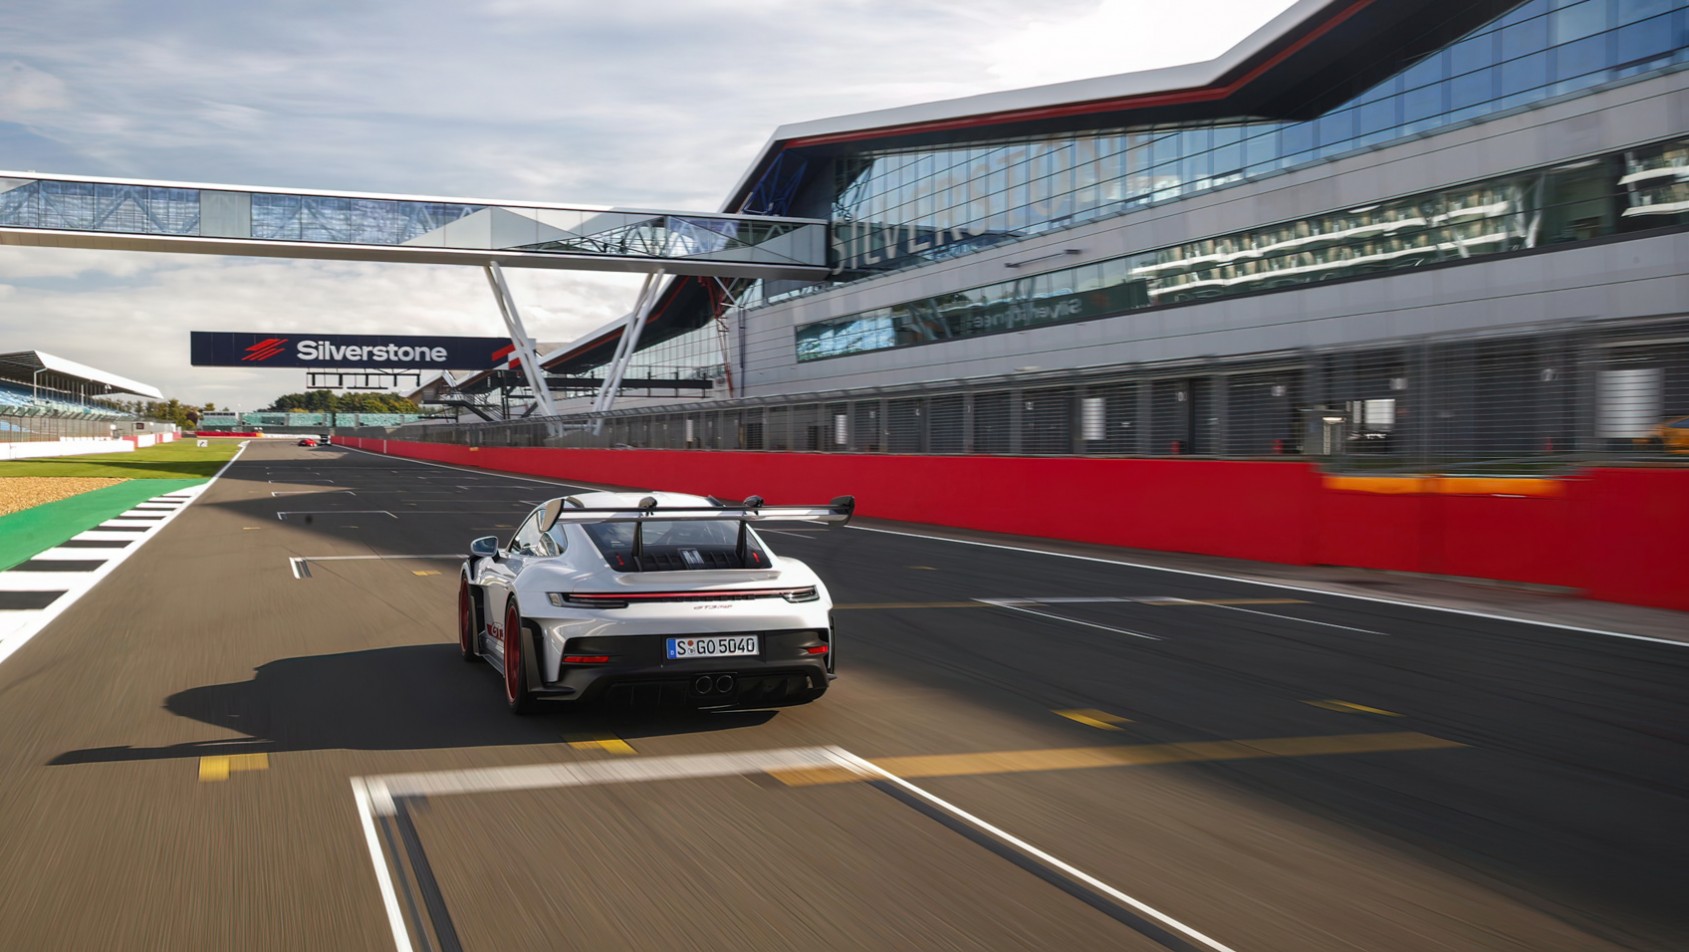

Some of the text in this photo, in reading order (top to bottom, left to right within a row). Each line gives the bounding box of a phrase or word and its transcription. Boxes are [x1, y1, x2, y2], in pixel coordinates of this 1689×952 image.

[297, 340, 448, 362] Silverstone
[677, 637, 755, 655] S GO 5040
